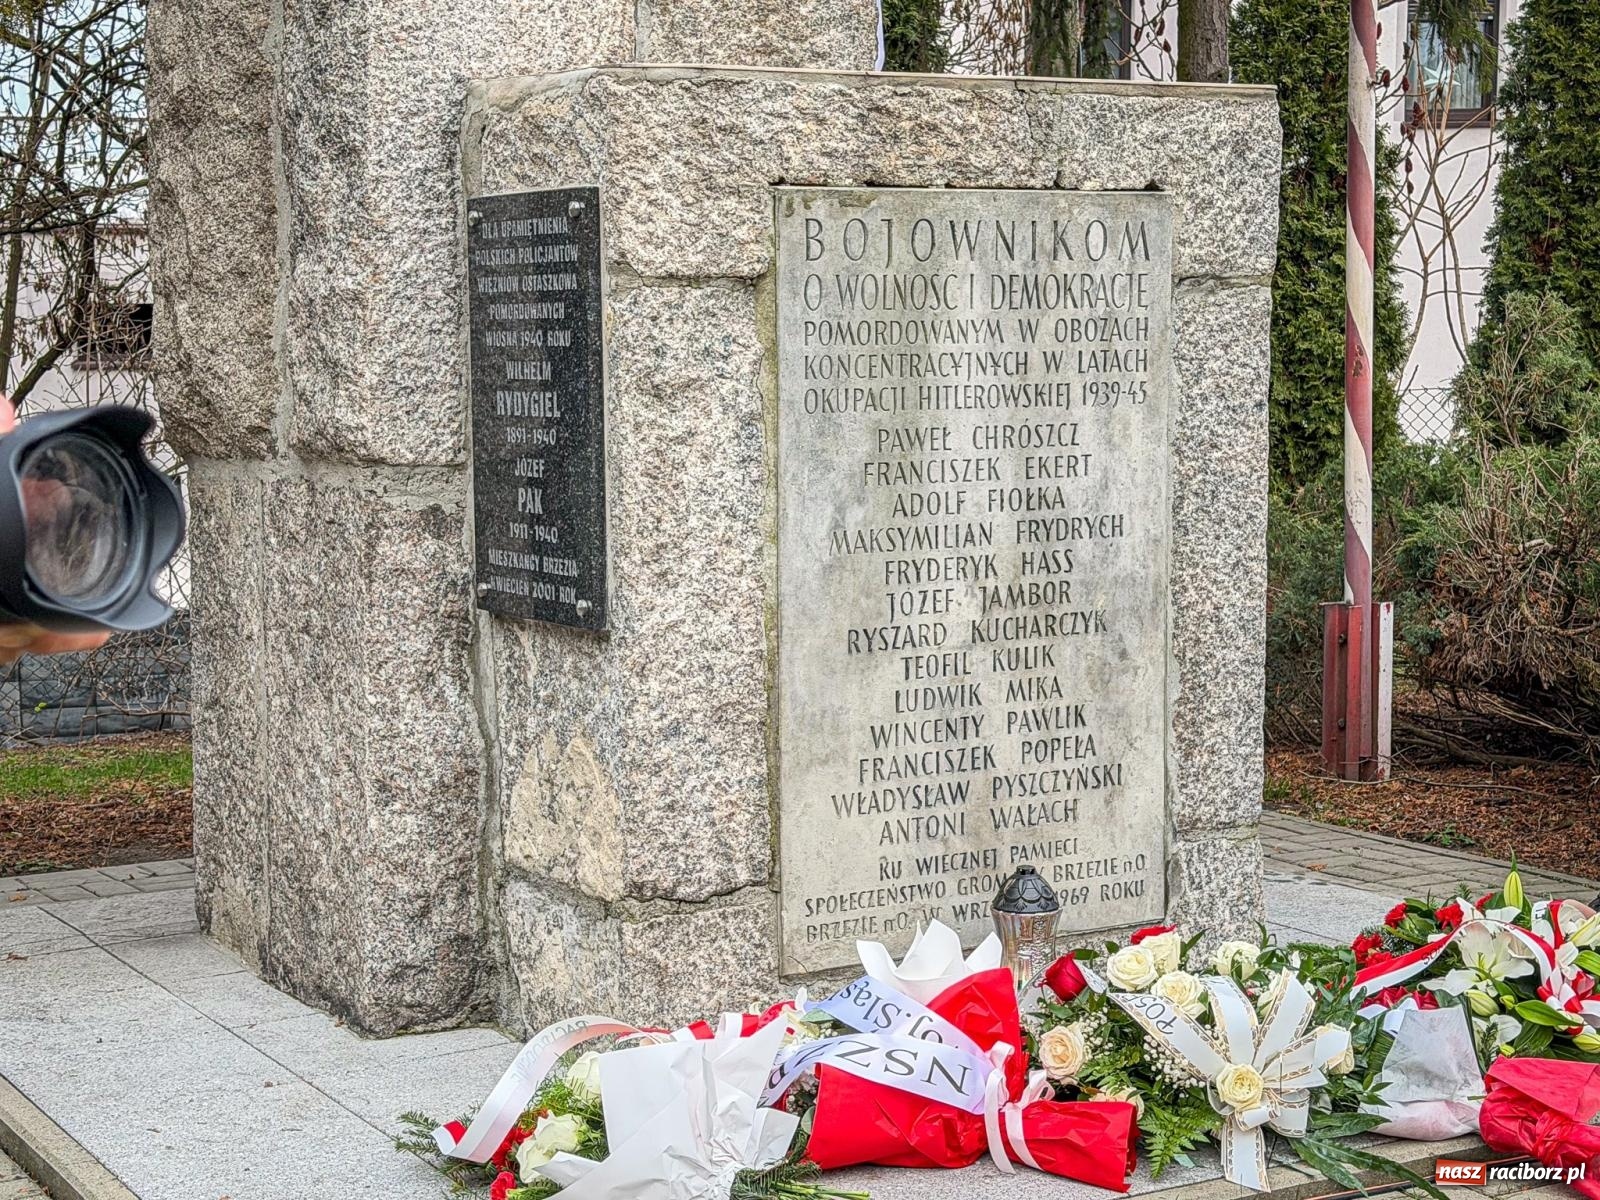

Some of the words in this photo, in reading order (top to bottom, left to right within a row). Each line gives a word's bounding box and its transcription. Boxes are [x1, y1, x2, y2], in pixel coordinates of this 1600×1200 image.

[482, 222, 499, 239] DLA
[501, 216, 568, 240] UPAMIĘTNIENIA
[804, 217, 1151, 269] BOJOWNIKOM
[475, 249, 516, 266] POLSKICH
[518, 240, 579, 264] POLICJANTÓW
[522, 273, 578, 291] OSTASZKOWA
[803, 273, 823, 311] O
[970, 273, 975, 310] I
[991, 273, 1148, 312] DEMOKRACJĘ
[489, 302, 565, 320] POMORDOWANYCH
[521, 330, 543, 348] 1940
[548, 330, 571, 347] ROKU
[804, 318, 1005, 346] POMORDOWANYM
[1018, 318, 1040, 343] W
[1054, 317, 1149, 343] OBOZACH
[506, 361, 551, 380] WILHELM
[804, 351, 1028, 381] KONCENTRACYJNYCH
[1043, 350, 1064, 374] W
[1077, 349, 1149, 374] LATACH
[496, 390, 561, 418] RYDYGIEL
[803, 386, 905, 415] OKUPACJI
[919, 382, 1070, 411] HITLEROWSKIEJ
[1082, 381, 1147, 407] 1939-45
[878, 427, 952, 453] PAWEŁ
[972, 418, 1080, 450] CHRÓSZCZ
[514, 454, 545, 478] JÓZEF
[864, 456, 1000, 486] FRANCISZEK
[1025, 453, 1092, 480] EKERT
[518, 488, 543, 514] PAK
[892, 491, 967, 518] ADOLF
[988, 486, 1066, 513] FIOŁKA
[829, 521, 993, 556] MAKSYMILIAN
[1016, 514, 1124, 544] FRYDRYCH
[488, 549, 540, 573] MIESZKAŃCY
[543, 558, 578, 578] BRZEZIA
[885, 554, 998, 585] FRYDERYK
[1021, 549, 1074, 576] HASS
[532, 583, 556, 601] 2001
[559, 587, 576, 605] ROK
[886, 587, 955, 624] JÓZEF
[979, 581, 1072, 616] JAMBOR
[847, 621, 947, 655] RYSZARD
[971, 609, 1107, 644] KUCHARCZYK
[900, 652, 971, 681] TEOFIL
[992, 644, 1055, 673] KULIK
[895, 682, 982, 713] LUDWIK
[1005, 675, 1063, 703] MIKA
[870, 714, 985, 749] WINCENTY
[1007, 704, 1087, 734] PAWLIK
[859, 744, 997, 784] FRANCISZEK
[1021, 734, 1097, 765] POPEŁA
[831, 780, 971, 818] WŁADYSŁAW
[992, 763, 1123, 800] PYSZCZYŃSKI
[879, 811, 965, 846] ANTONI
[990, 798, 1080, 831] WAŁACH
[879, 859, 902, 881] KU
[915, 848, 998, 876] WIECZNEJ
[805, 884, 947, 917] SPOŁECZEŃSTWO
[1053, 857, 1118, 883] BRZEZIE
[1100, 880, 1145, 901] ROKU
[806, 916, 878, 943] BRZEZIE
